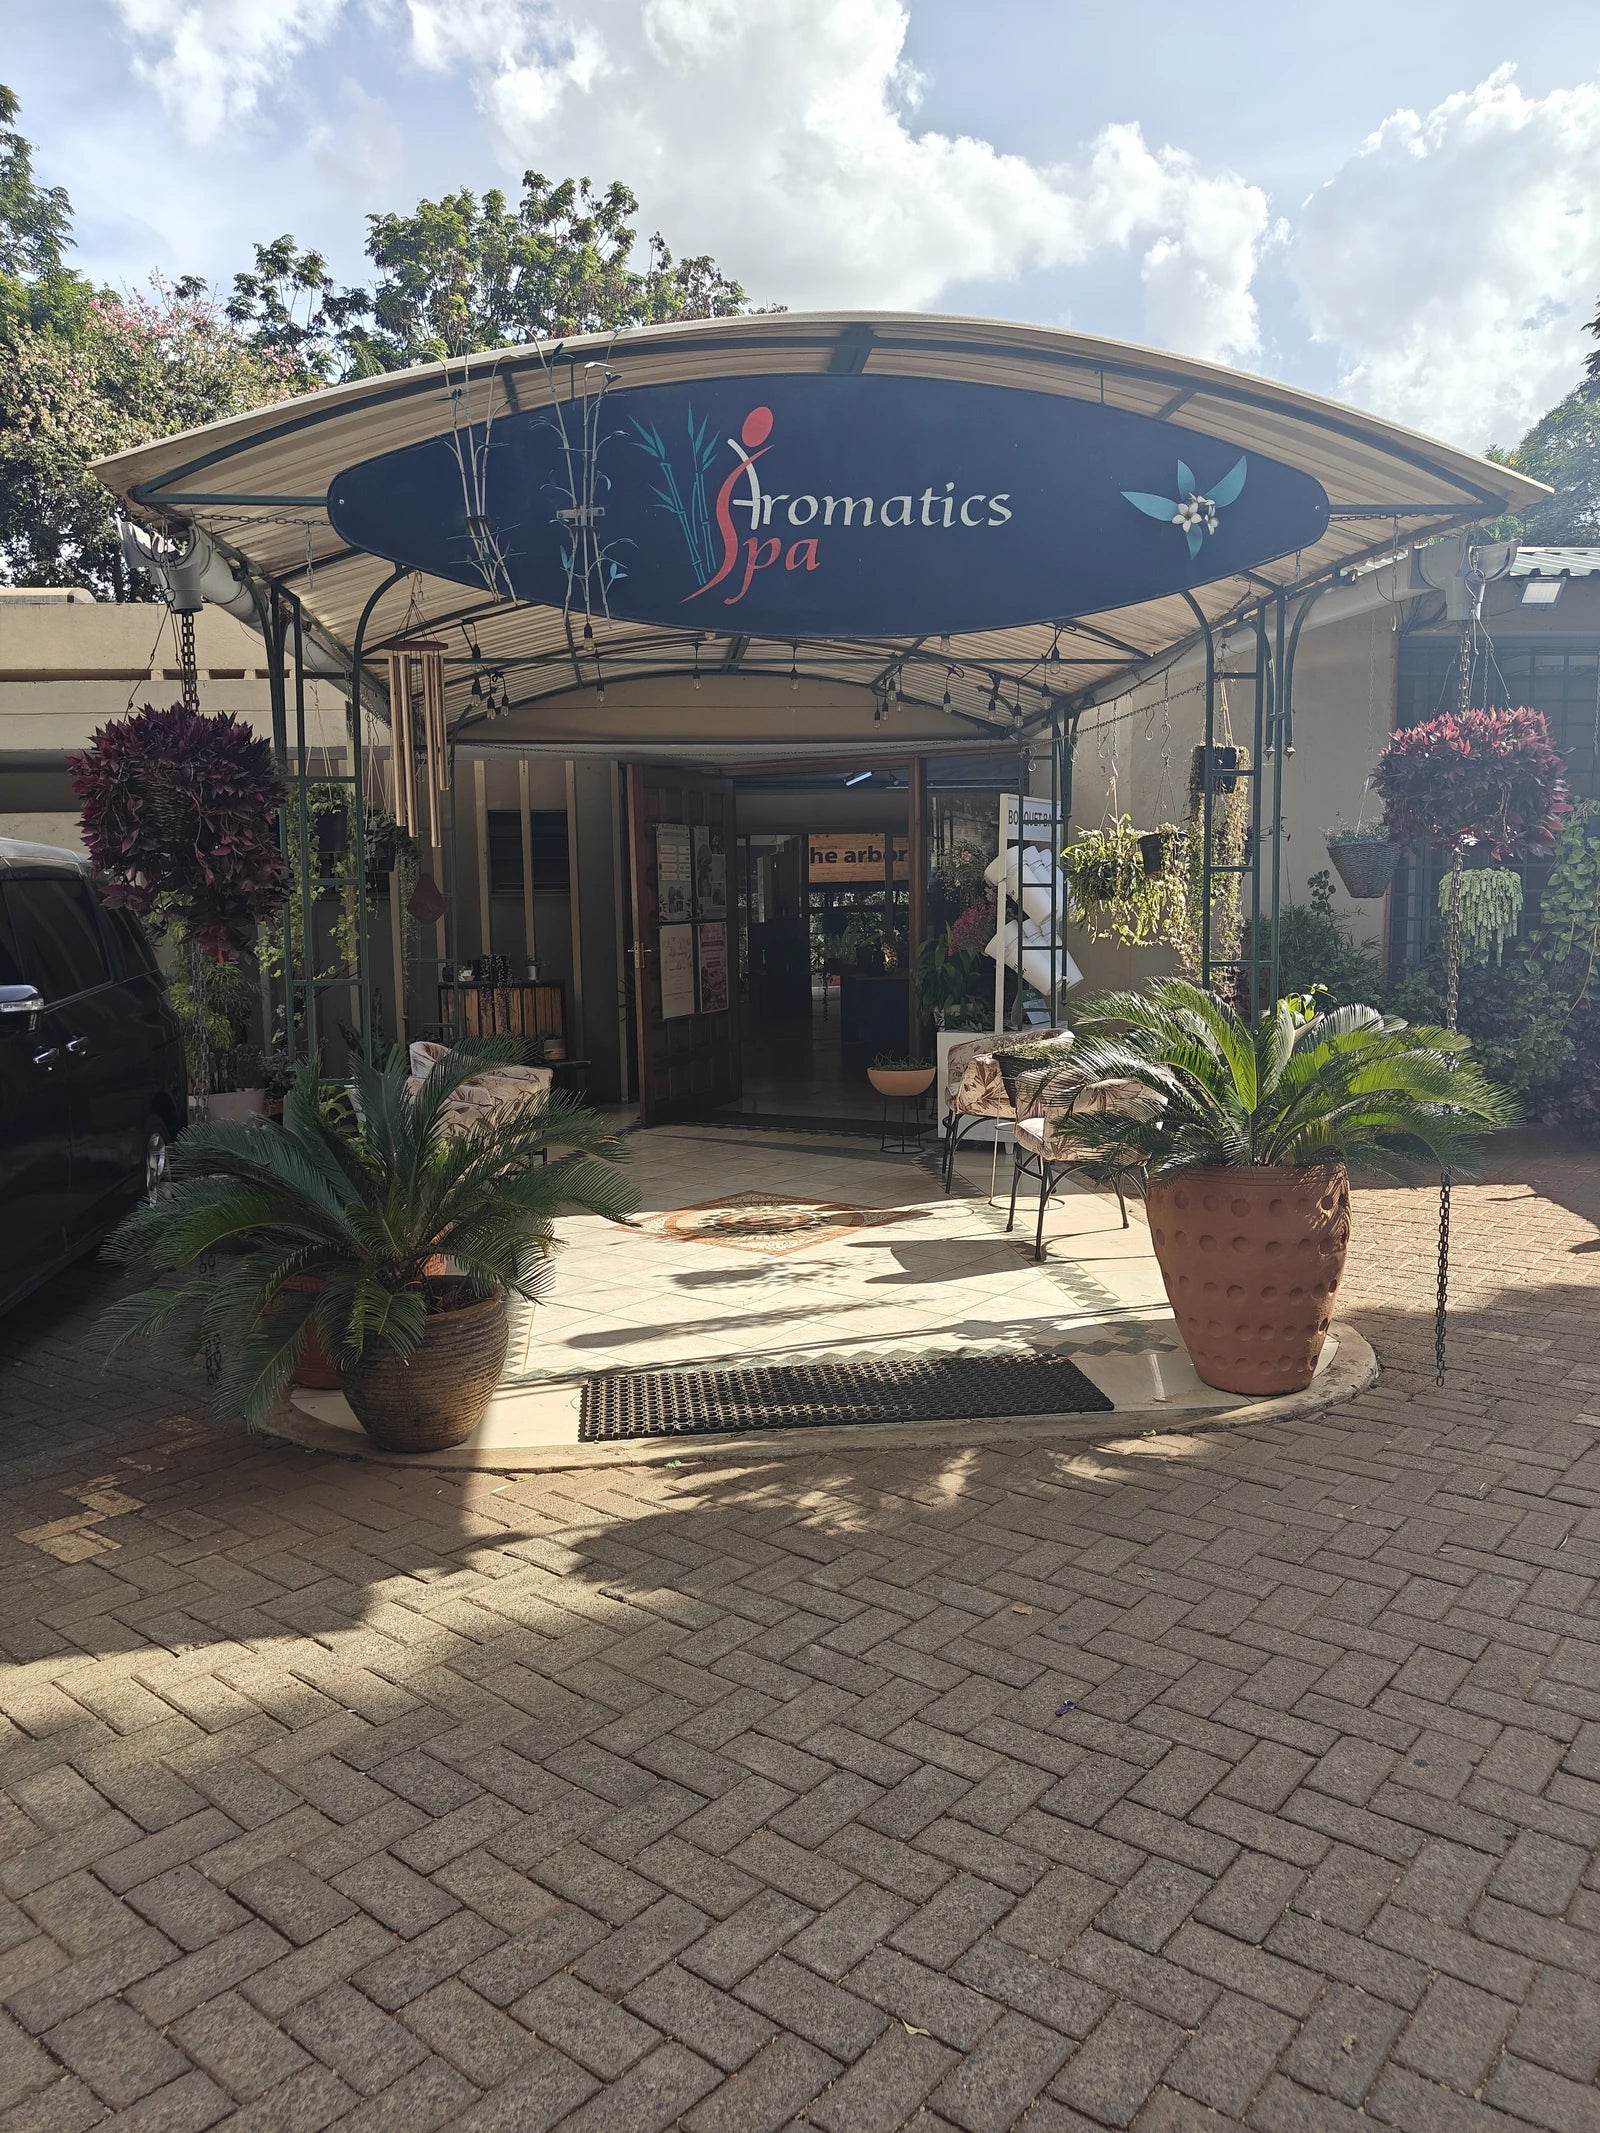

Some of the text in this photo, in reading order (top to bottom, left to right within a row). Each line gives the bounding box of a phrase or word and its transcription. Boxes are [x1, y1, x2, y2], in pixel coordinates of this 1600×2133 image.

[681, 445, 821, 605] Spa
[727, 438, 1013, 530] Aromatics
[1007, 809, 1042, 828] BOQUET
